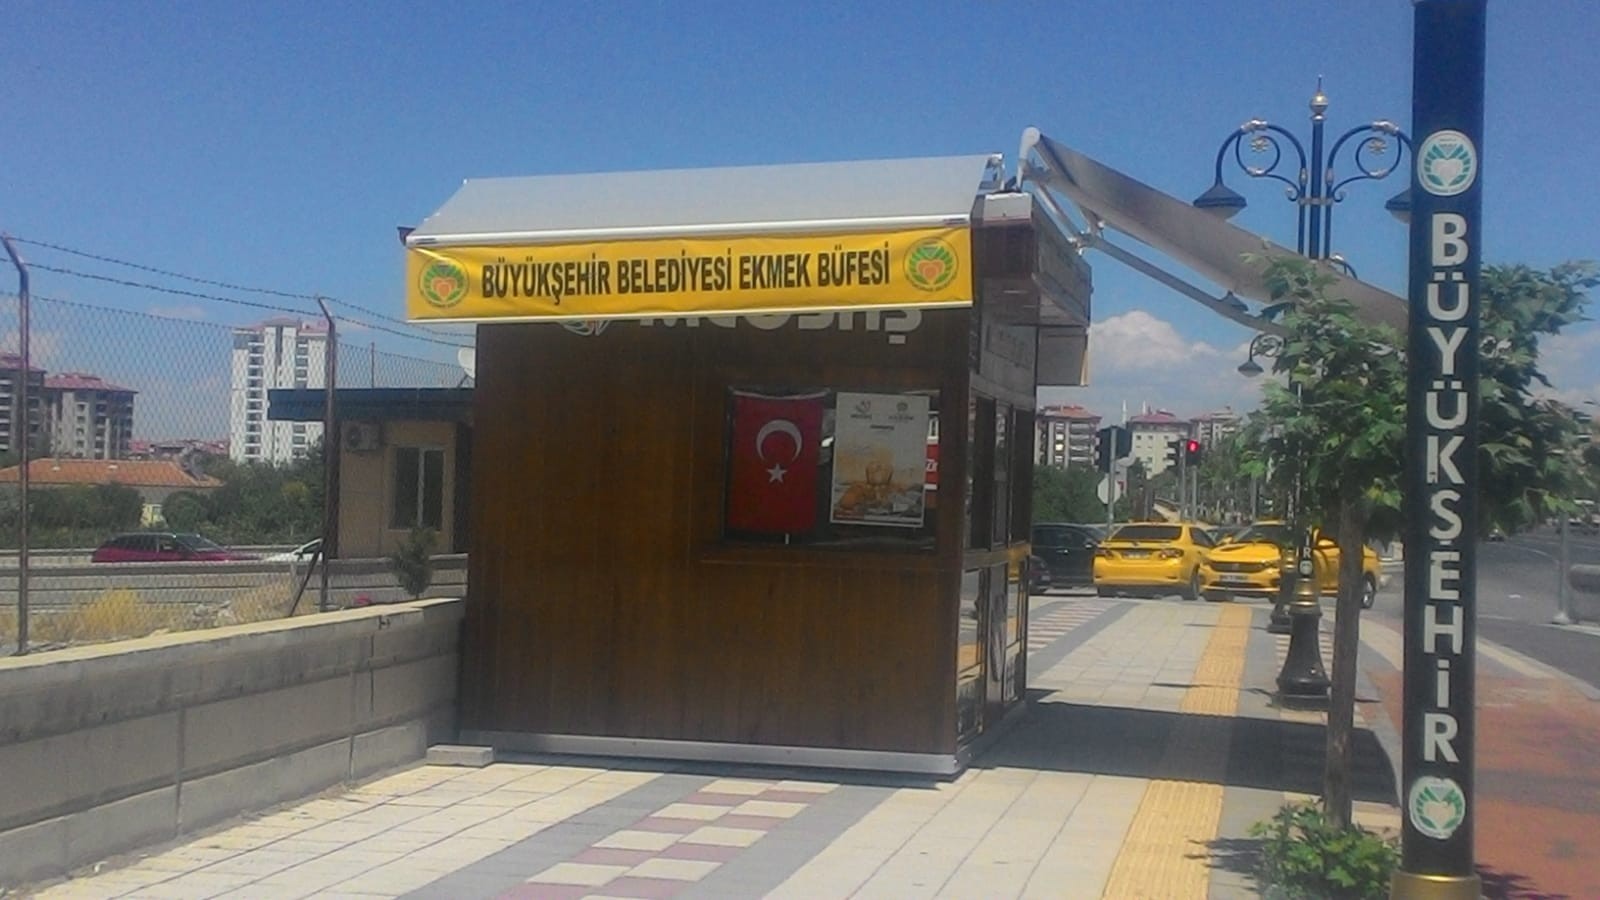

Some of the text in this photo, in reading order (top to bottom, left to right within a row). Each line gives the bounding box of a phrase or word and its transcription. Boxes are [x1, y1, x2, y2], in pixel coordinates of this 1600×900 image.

[482, 241, 890, 306] BÜYÜKŞEHİR BELEDİYESİ EKMEK BÜFESİ
